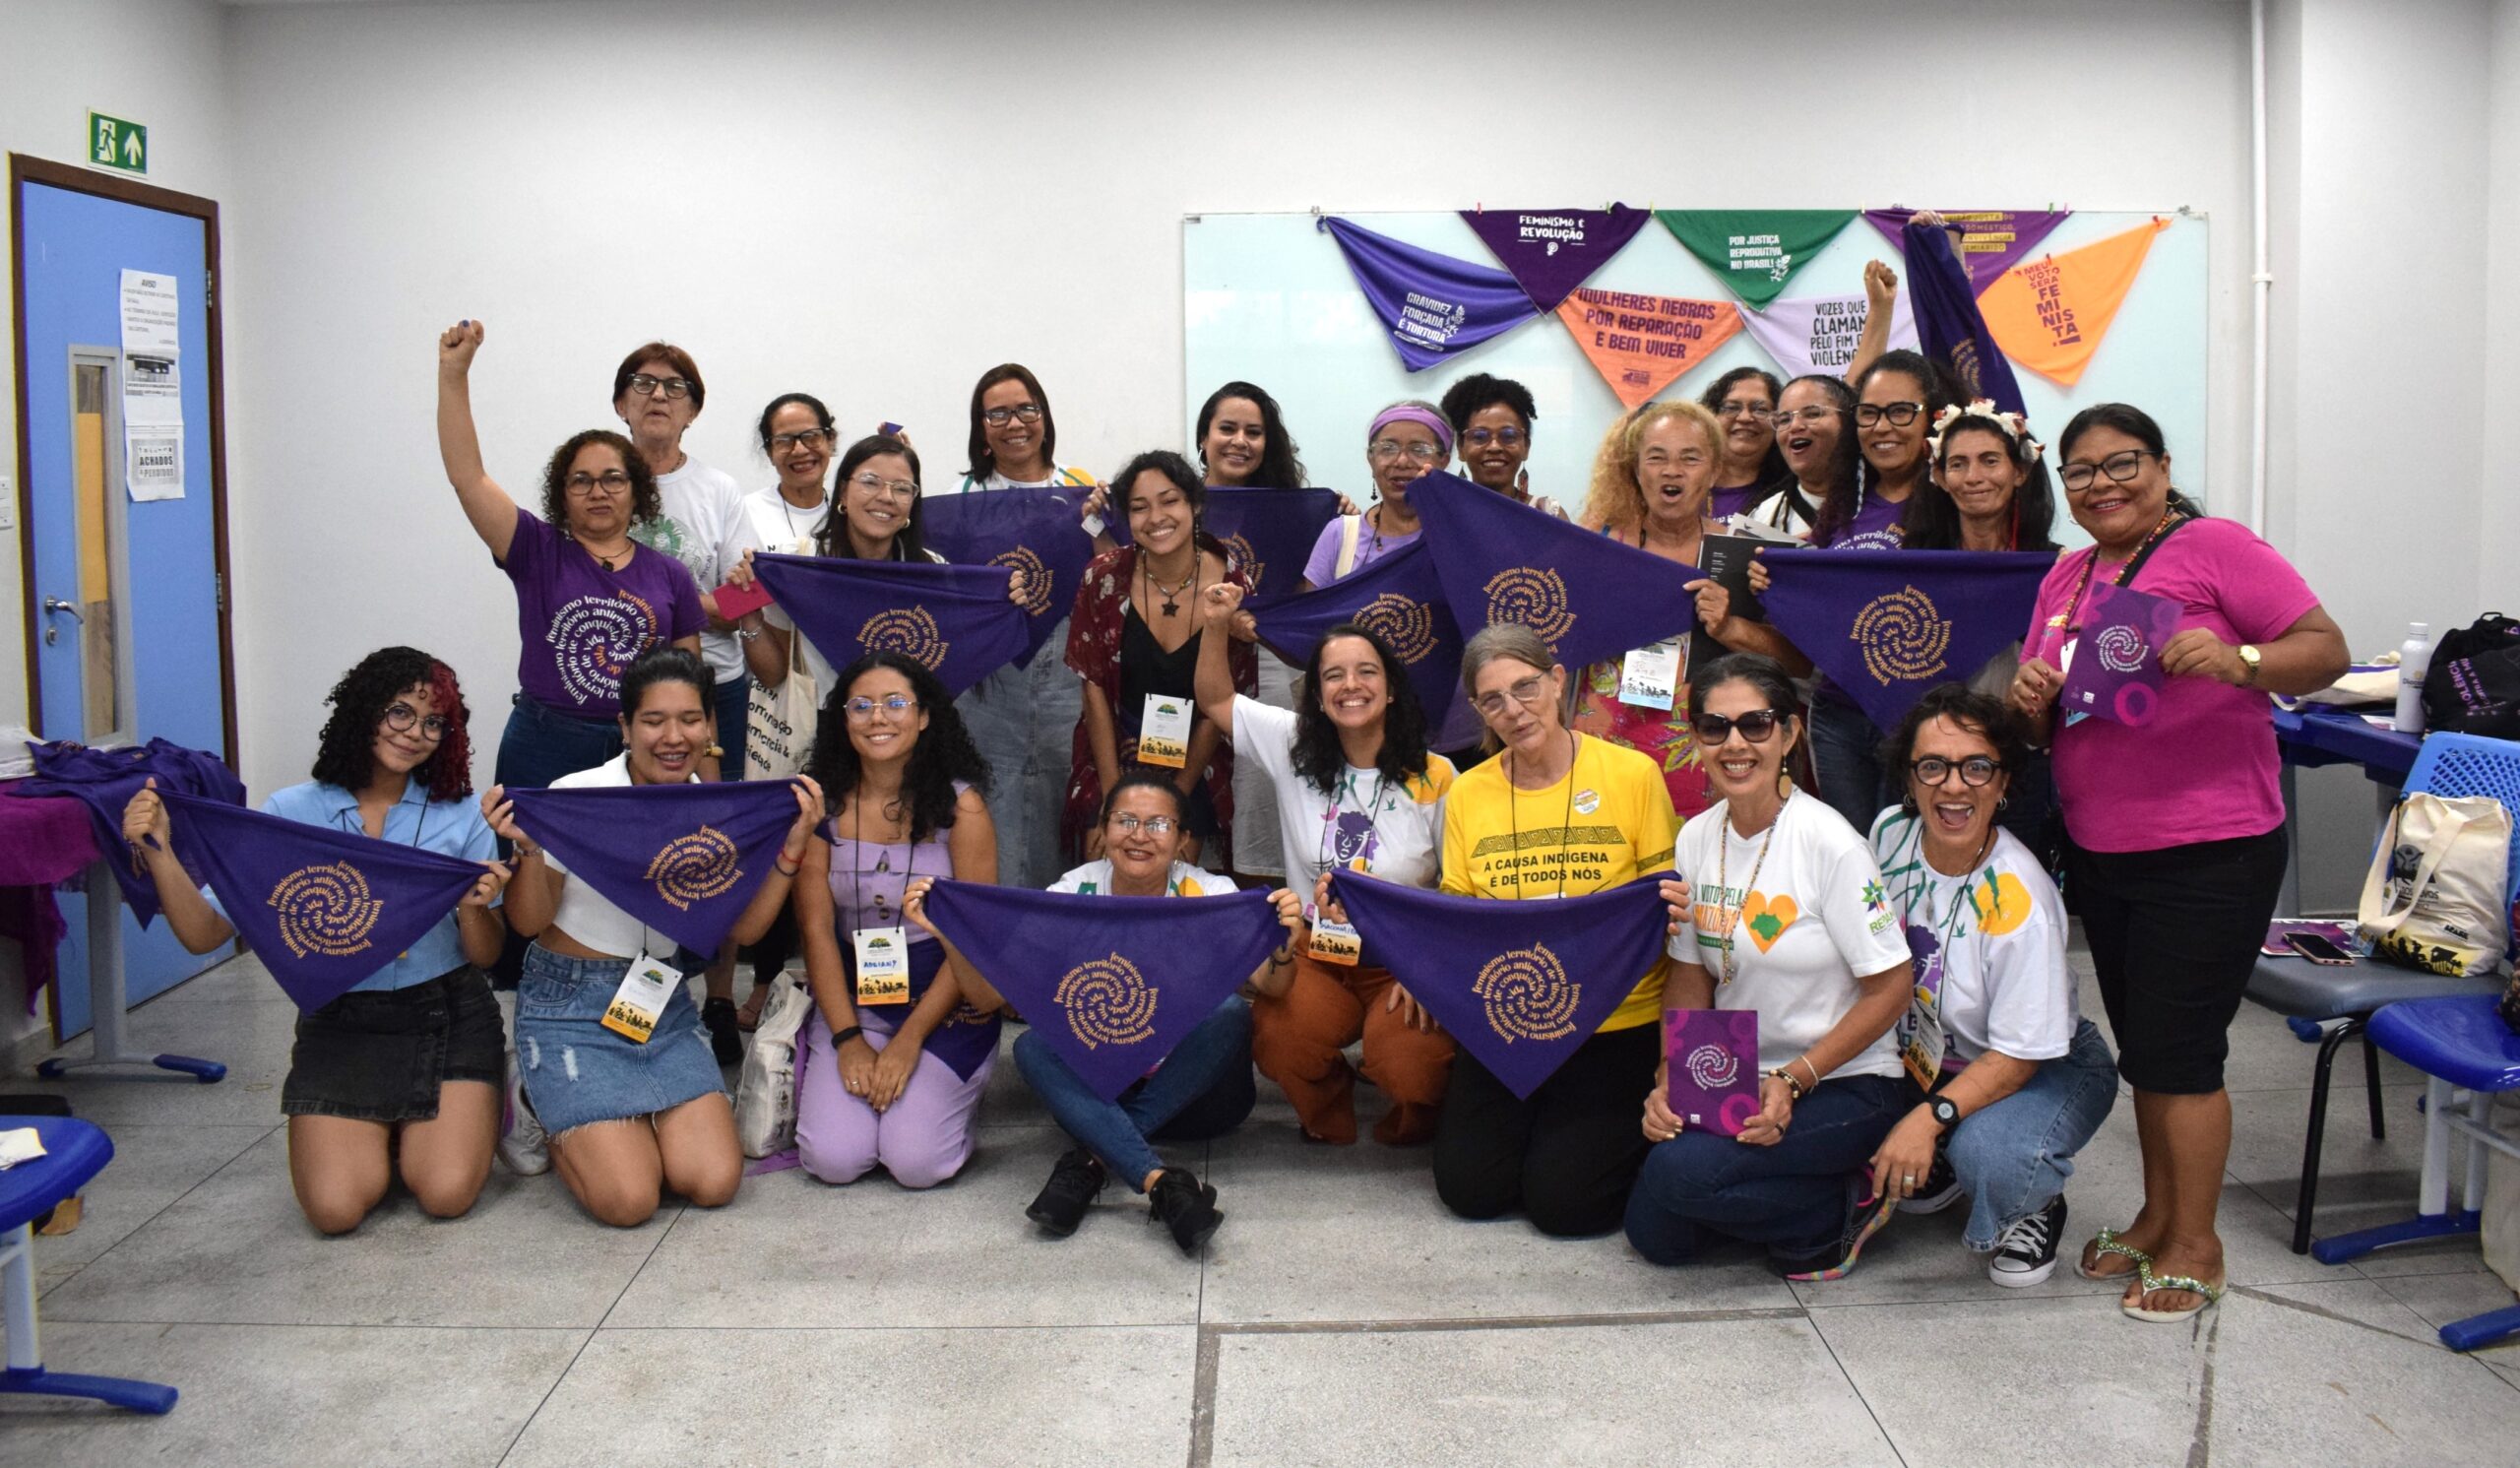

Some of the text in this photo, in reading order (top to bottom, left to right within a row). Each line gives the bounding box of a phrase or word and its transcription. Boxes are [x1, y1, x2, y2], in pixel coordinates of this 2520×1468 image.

[1519, 215, 1575, 226] FEMINISMO
[1520, 226, 1584, 242] REVOLUÇÃO
[1729, 234, 1780, 246] POR JUSTIÇA
[1730, 246, 1783, 258] REPRODUTIVA
[1731, 260, 1742, 270] NO
[2024, 262, 2048, 275] MEU
[2028, 267, 2060, 282] VOTO
[1406, 291, 1452, 316] GRAVIDEZ
[1577, 287, 1716, 321] MULHERES NEGRAS
[1815, 299, 1866, 316] VOZES QUE
[1402, 305, 1444, 329] FORÇADA
[1586, 308, 1703, 342] POR REPARAÇÃO
[1398, 317, 1406, 329] É
[1406, 321, 1447, 344] TORTURA
[1595, 331, 1686, 359] E BEM VIVER
[1810, 336, 1832, 350] PELO
[1835, 335, 1853, 349] FIM
[140, 456, 173, 466] ACHADOS
[545, 599, 582, 643] feminismo
[584, 595, 637, 615] território
[635, 616, 647, 629] de
[618, 589, 658, 633] feminismo
[554, 609, 590, 650] território
[567, 639, 578, 654] de
[574, 619, 619, 642] conquista
[583, 634, 604, 651] vida
[581, 655, 592, 669] de
[607, 665, 621, 675] de
[556, 653, 588, 706] feminismo
[1483, 850, 1608, 872] A CAUSA INDÍGENA
[1490, 866, 1602, 887] É DE TODOS NÓS
